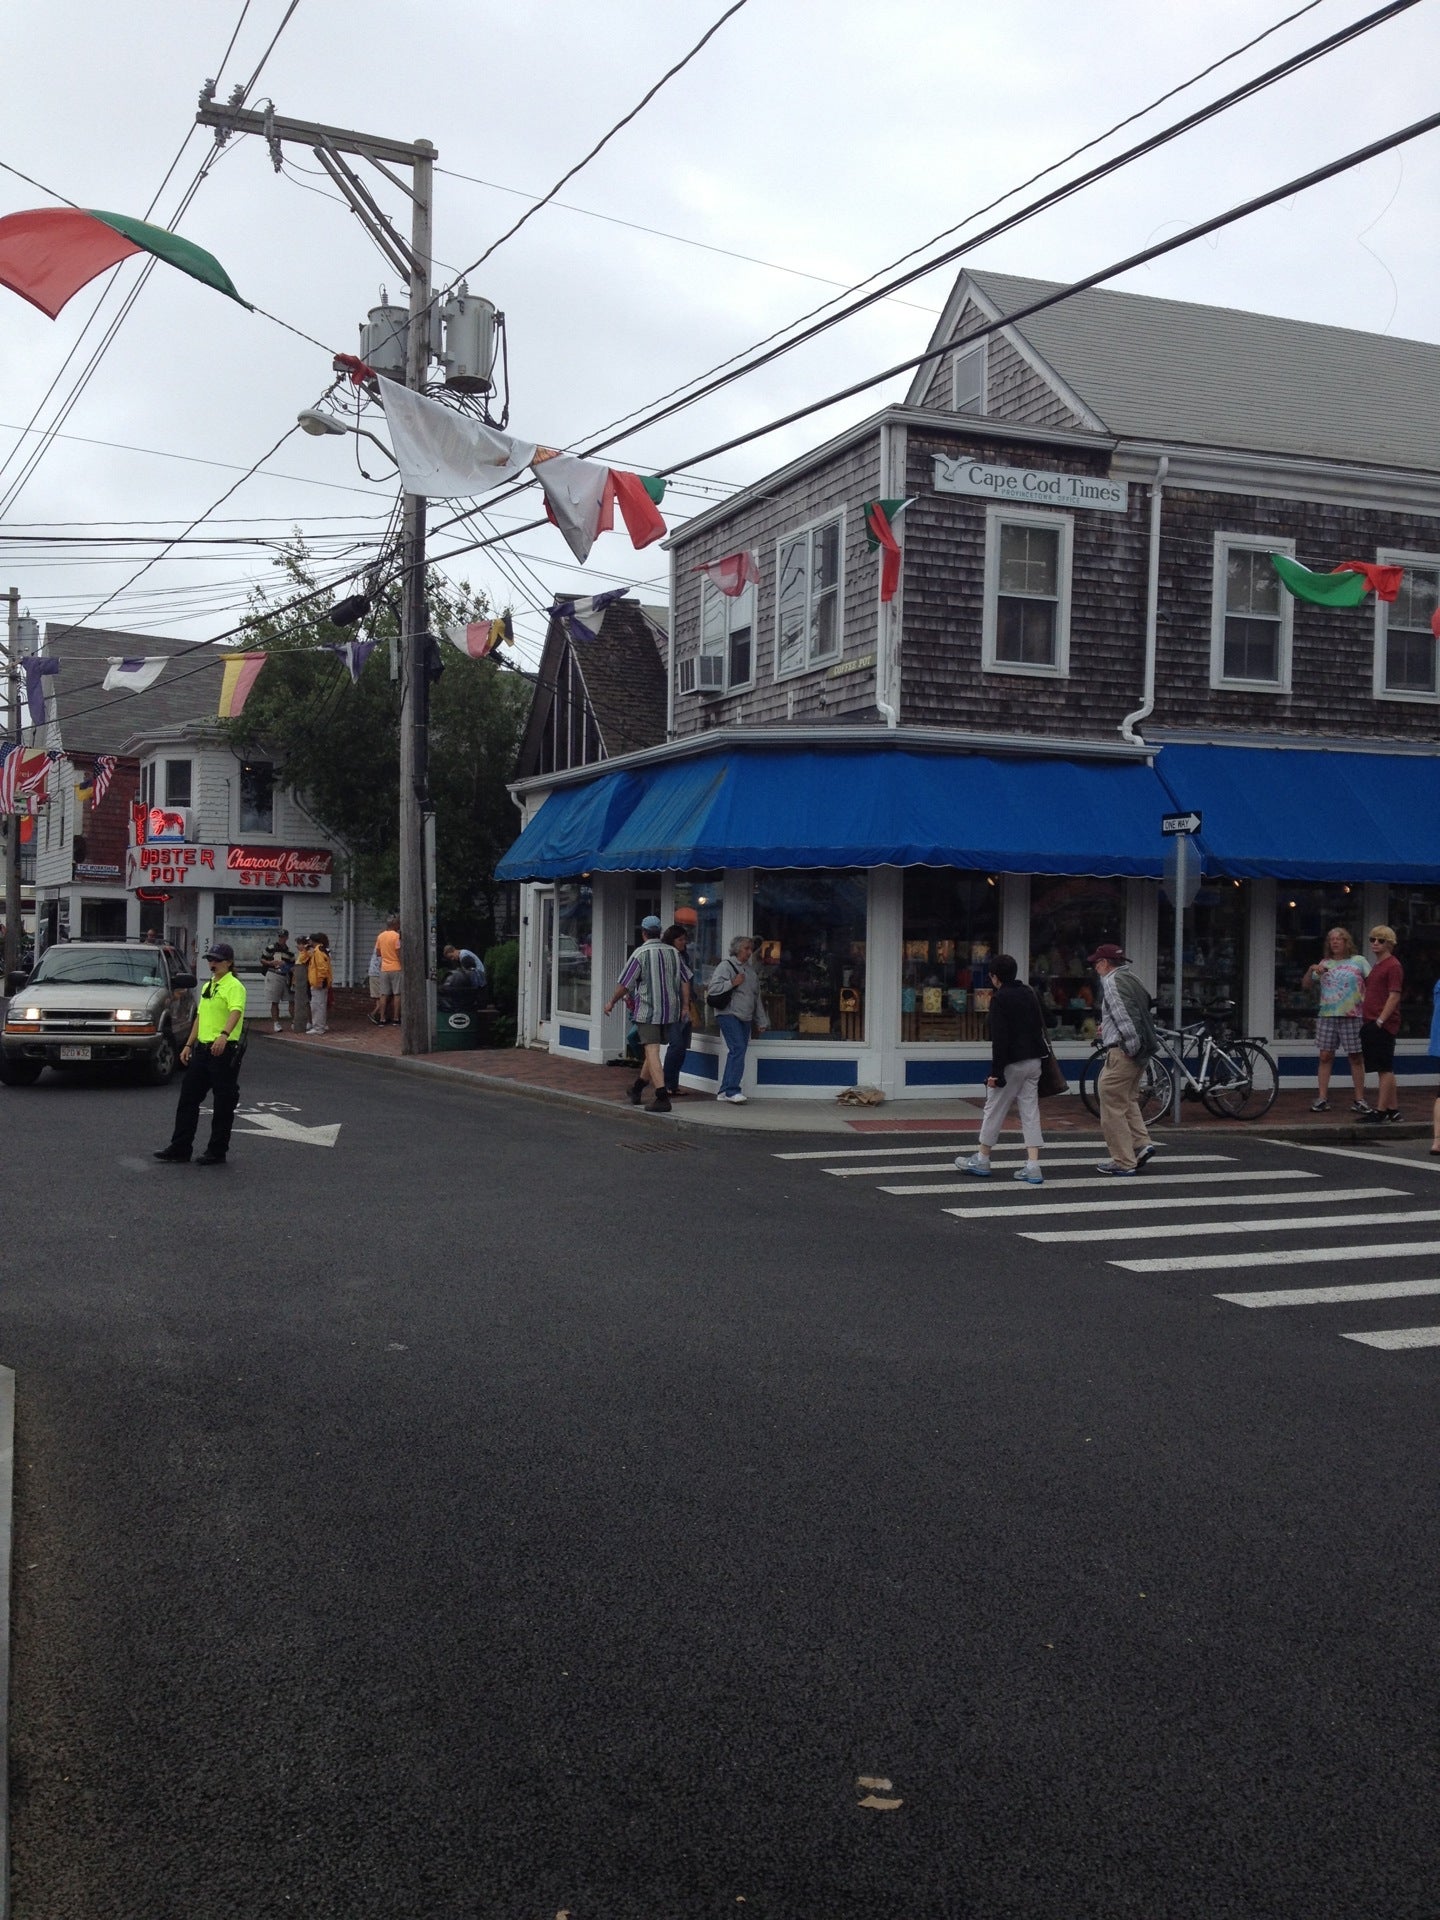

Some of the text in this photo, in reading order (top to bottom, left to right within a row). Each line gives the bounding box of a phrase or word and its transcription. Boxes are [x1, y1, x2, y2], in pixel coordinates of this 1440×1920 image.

[968, 466, 1121, 502] Cape Cod Times
[1001, 488, 1053, 500] PROVINCETOWN
[1164, 819, 1190, 830] ONE WAY
[139, 847, 215, 870] LOBSTER
[227, 848, 333, 872] Charcoal Broiled
[149, 867, 189, 883] POT
[239, 870, 322, 888] STEAKS
